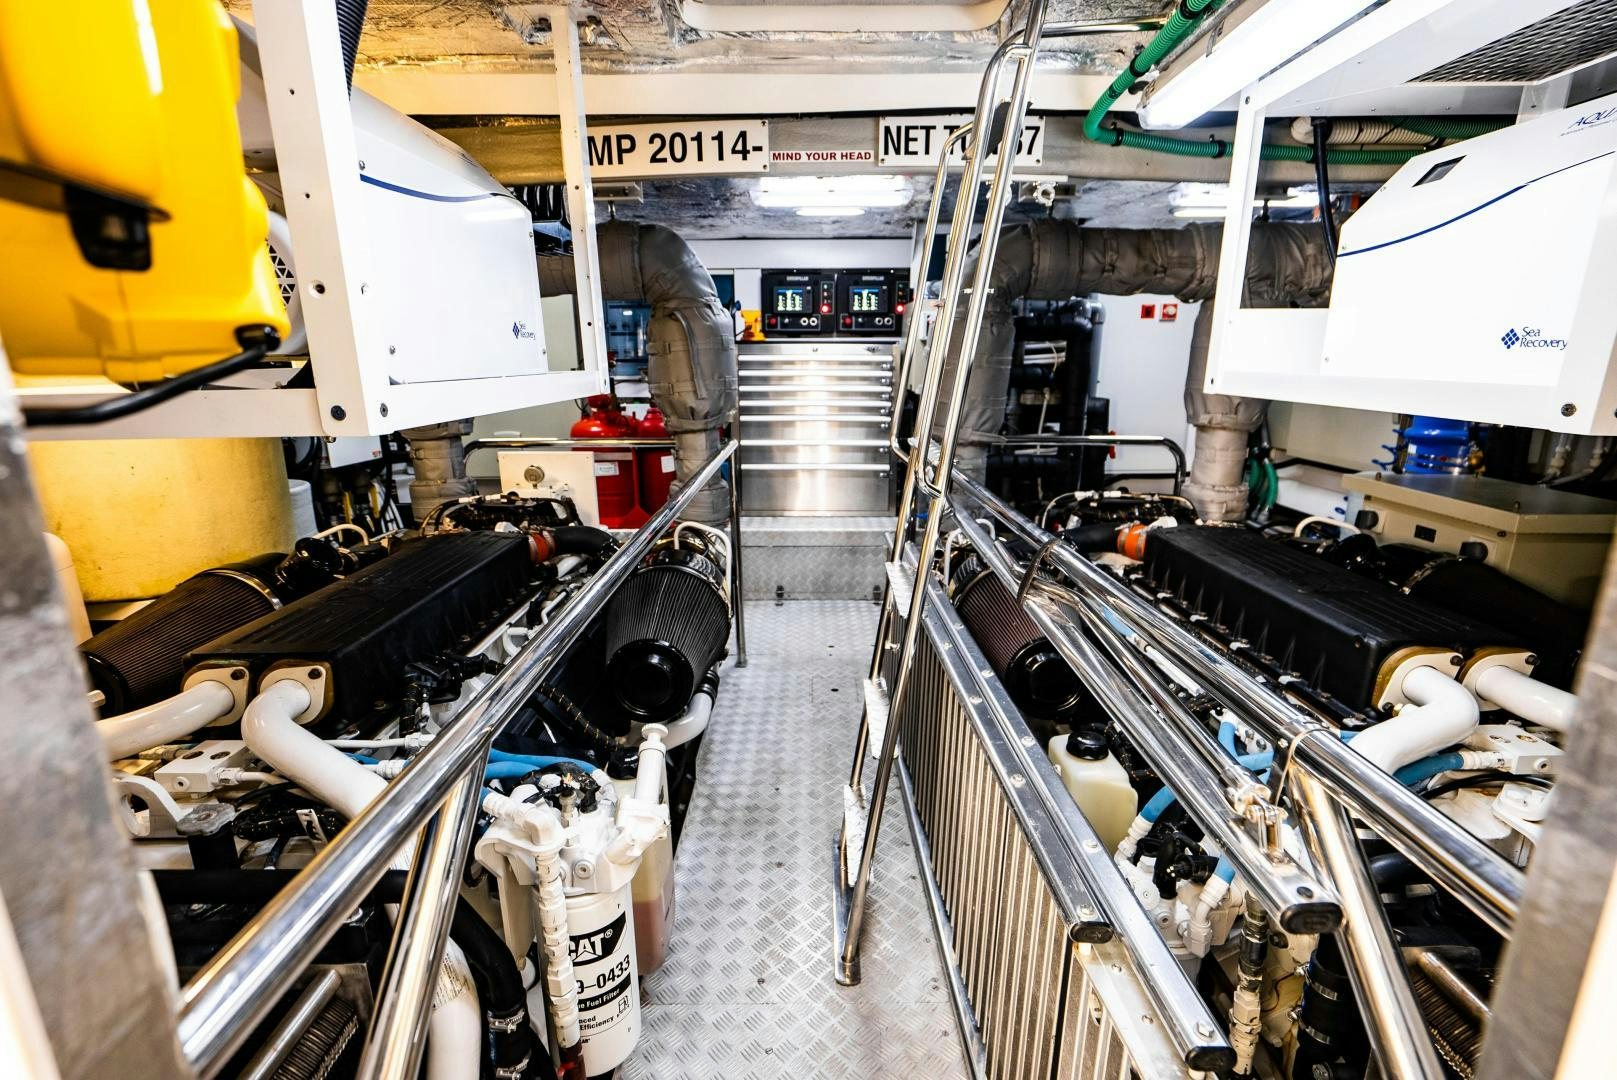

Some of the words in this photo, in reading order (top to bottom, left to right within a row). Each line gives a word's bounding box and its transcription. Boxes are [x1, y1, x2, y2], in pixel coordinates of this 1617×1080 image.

[648, 130, 763, 163] 20114-
[883, 125, 936, 156] NET
[772, 152, 802, 161] MIND
[805, 152, 837, 161] YOUR
[840, 151, 872, 161] HEAD
[1522, 326, 1541, 338] Sea
[1520, 337, 1568, 351] Recovery
[586, 997, 602, 1007] Fuel
[603, 988, 620, 1002] Filter
[579, 1015, 614, 1031] Efficiency
